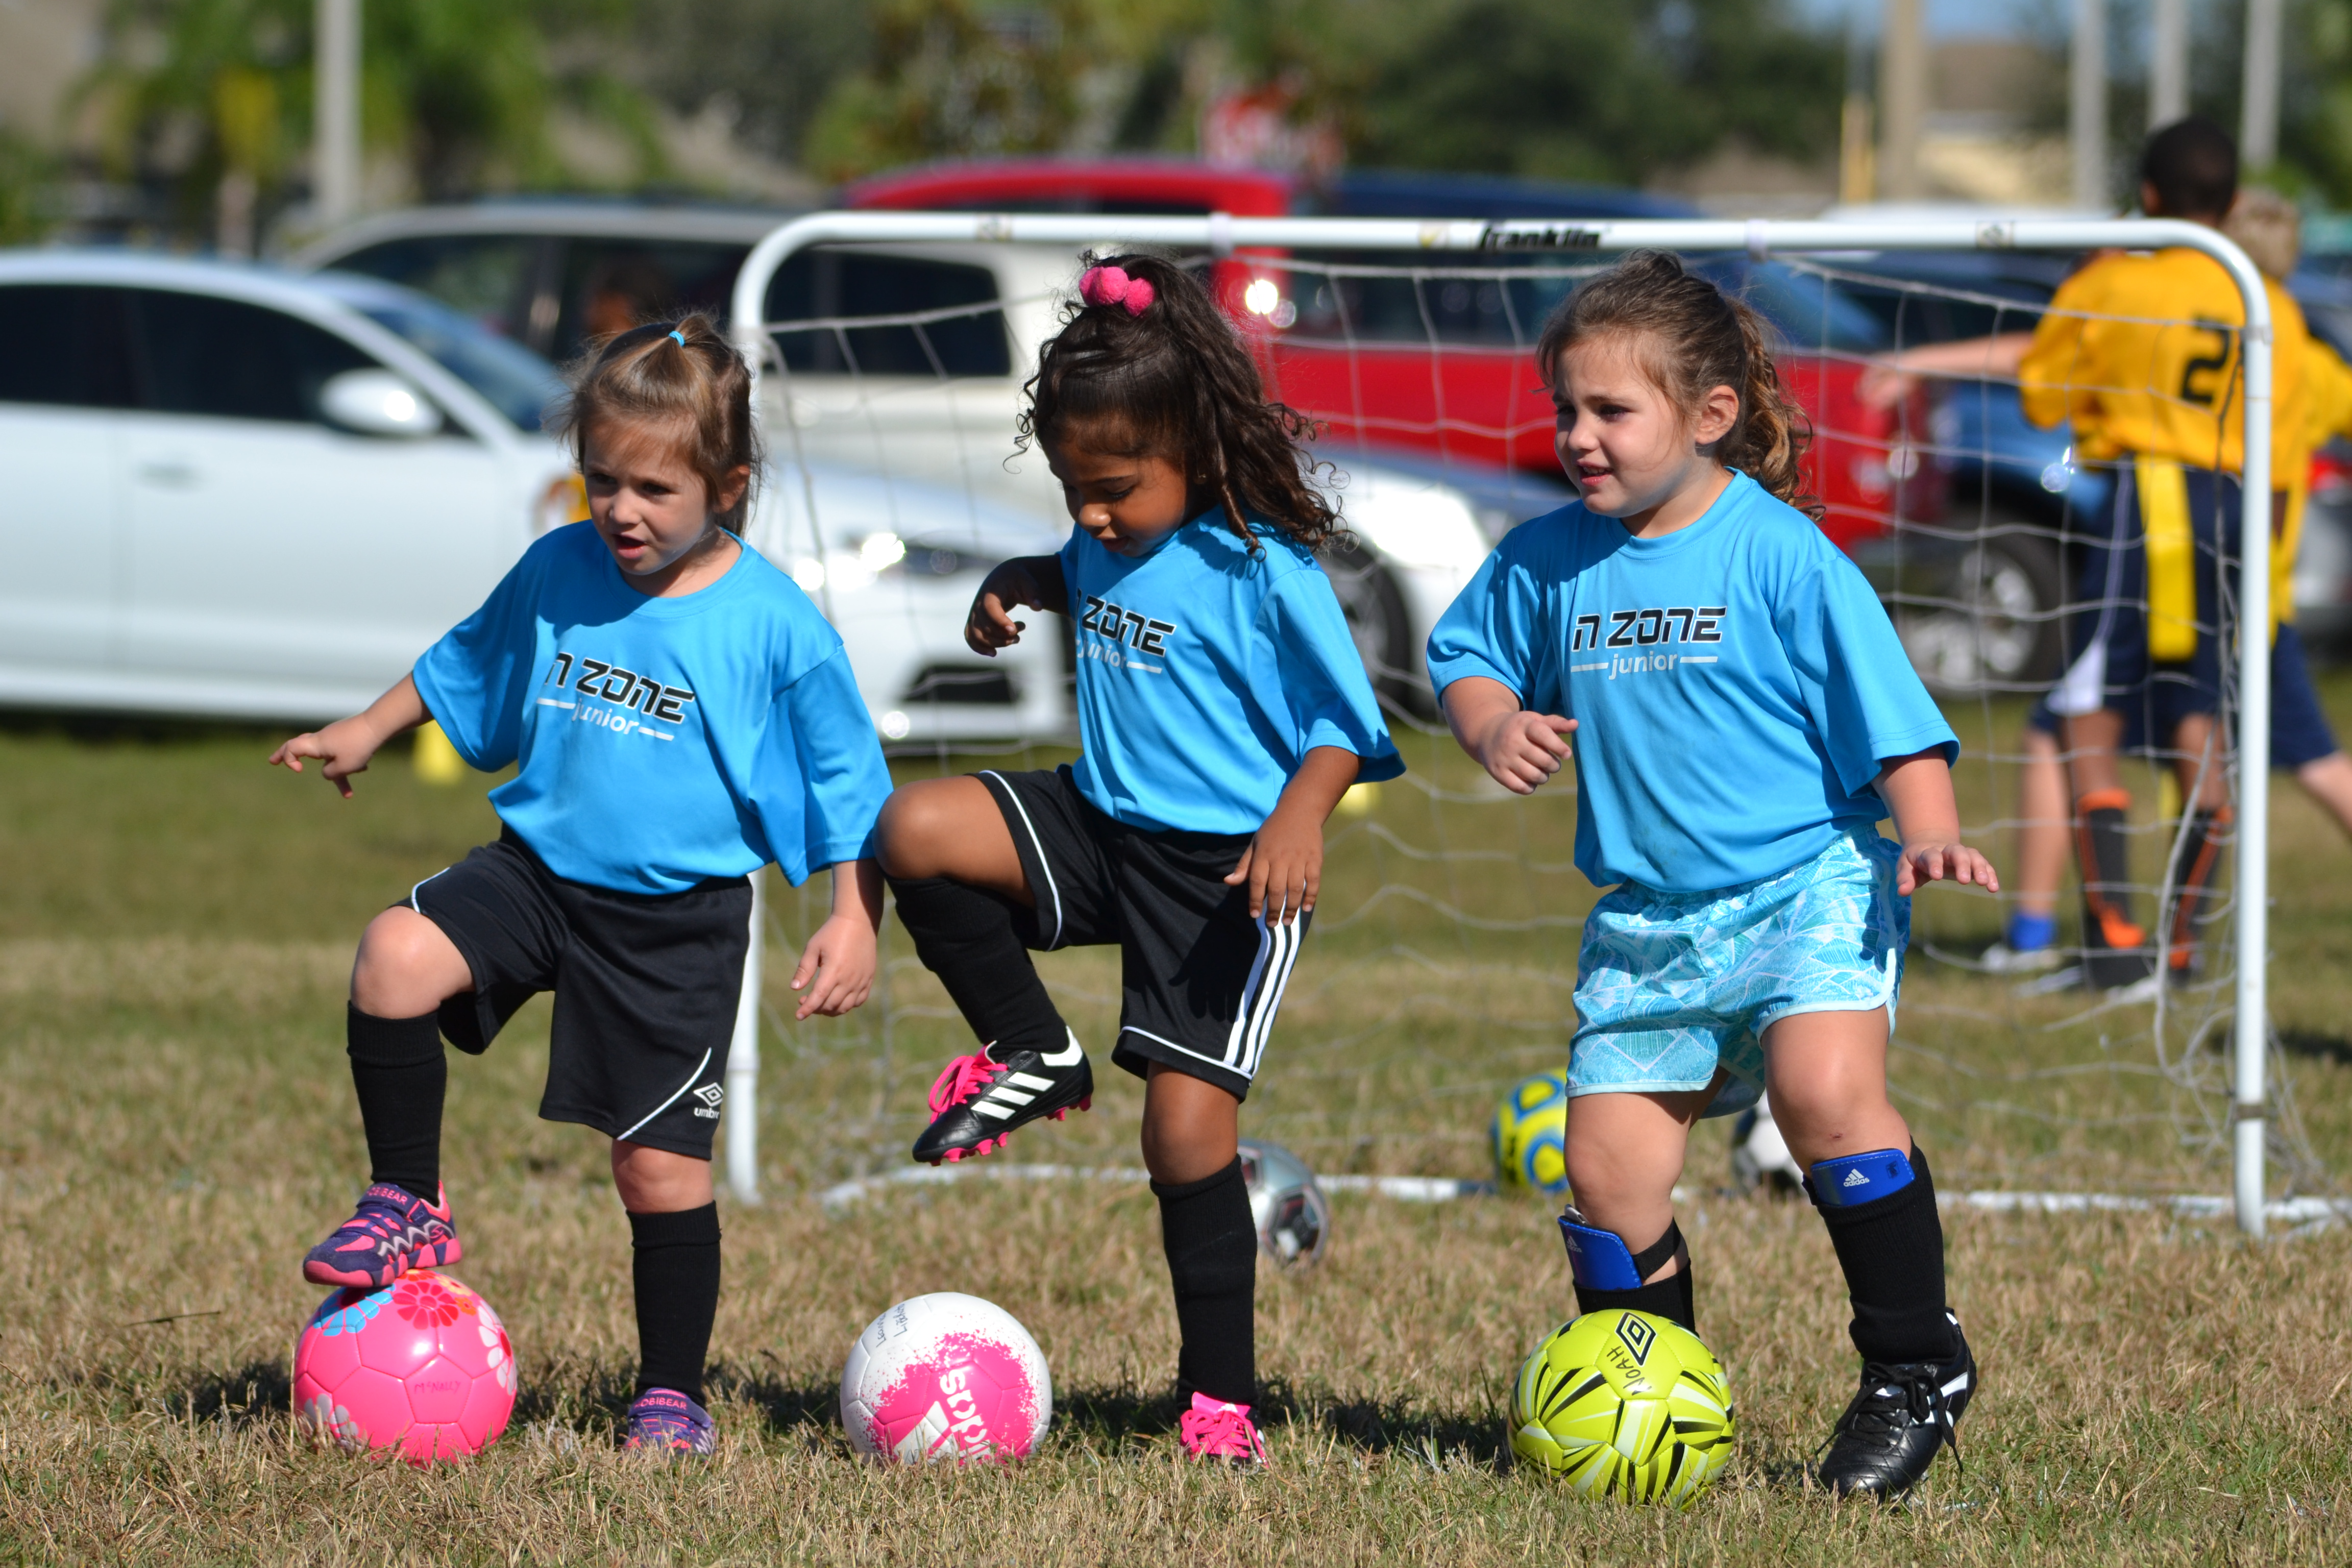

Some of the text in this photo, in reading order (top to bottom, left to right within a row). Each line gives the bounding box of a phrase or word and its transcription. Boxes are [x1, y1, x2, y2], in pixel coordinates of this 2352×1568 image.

[1082, 594, 1177, 657] ZONE
[1605, 606, 1727, 649] ZONE
[1608, 650, 1678, 680] junior
[575, 657, 696, 725] ZONE
[571, 697, 640, 734] junior
[1843, 1177, 1870, 1187] adidas
[1606, 1345, 1652, 1396] NOAH
